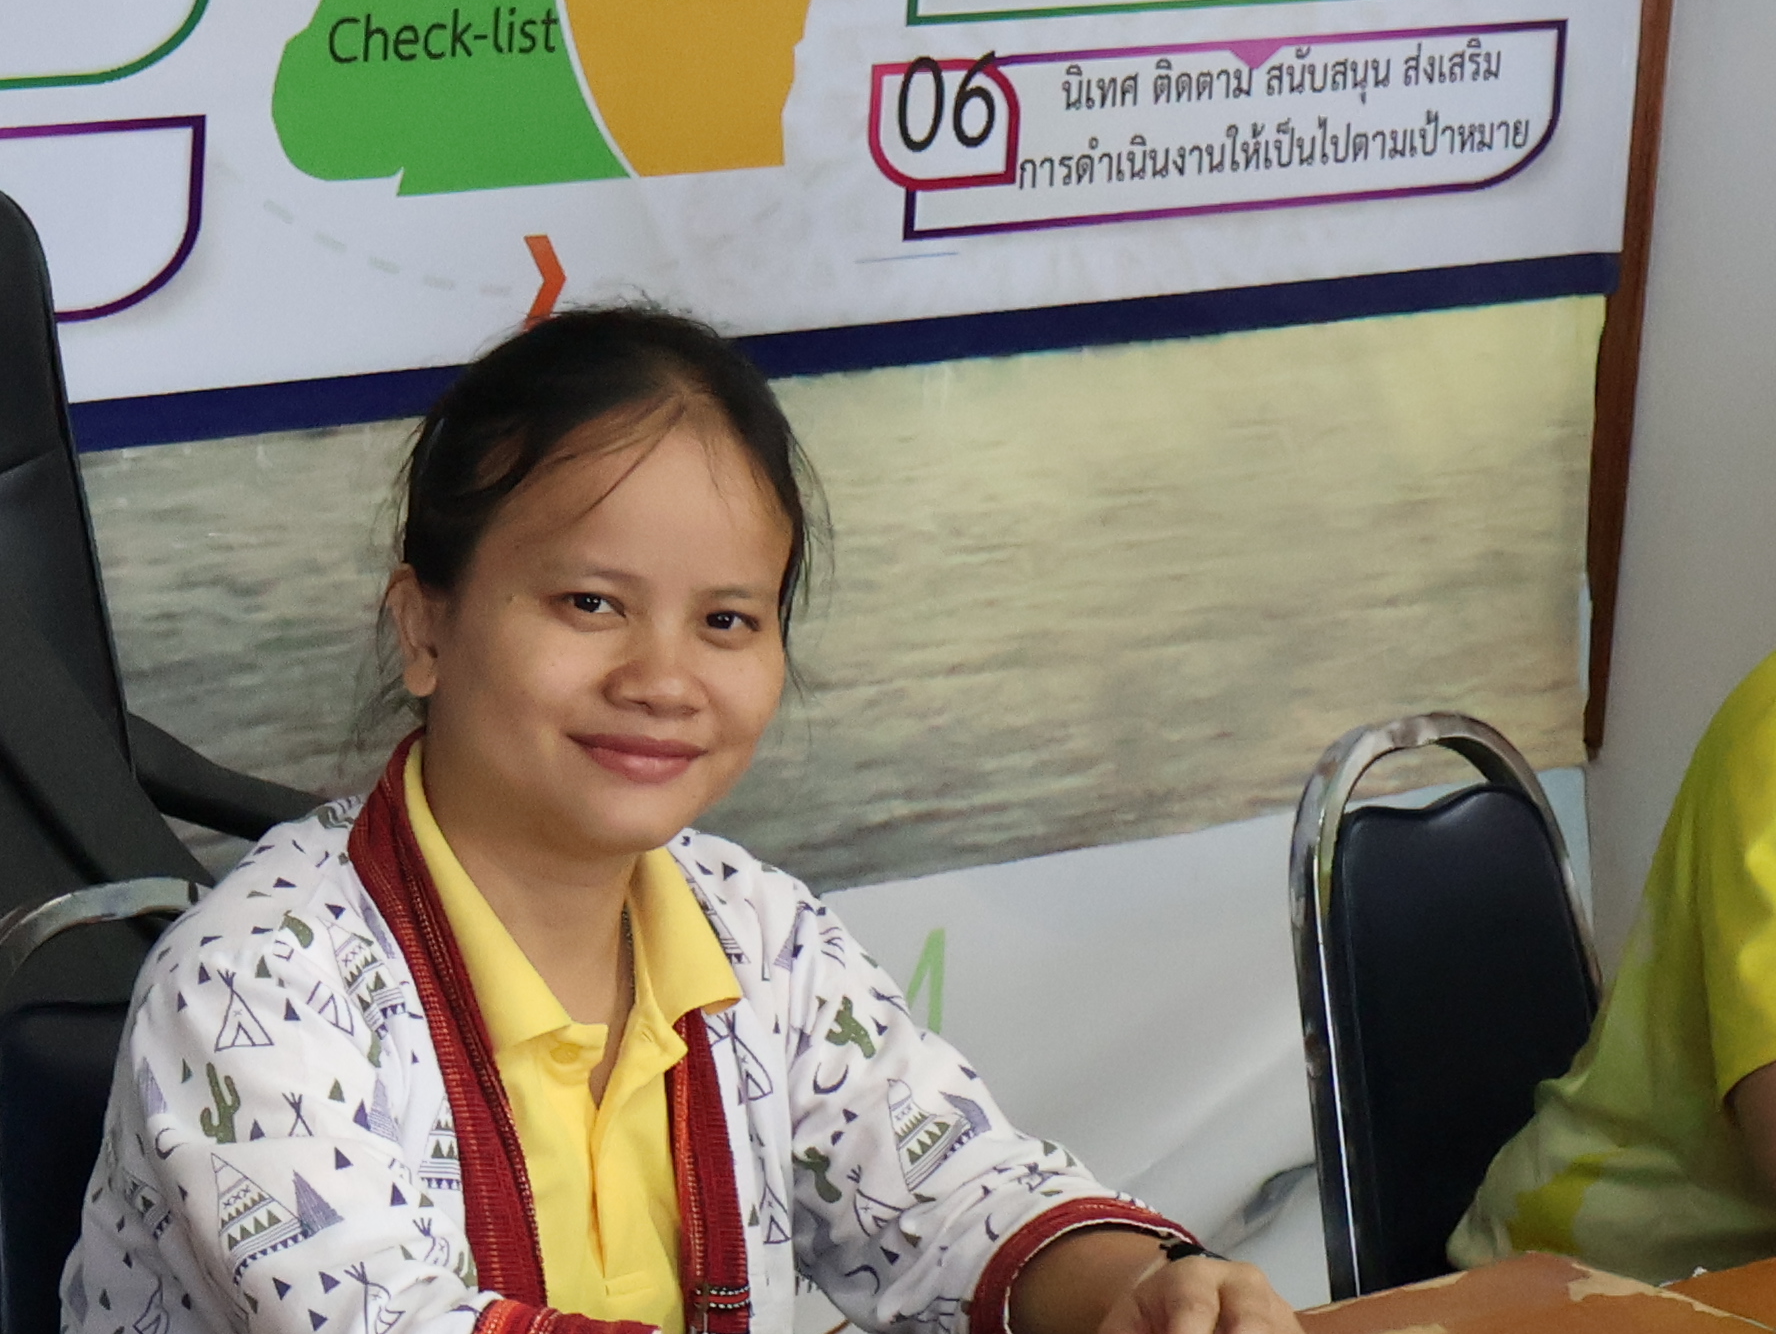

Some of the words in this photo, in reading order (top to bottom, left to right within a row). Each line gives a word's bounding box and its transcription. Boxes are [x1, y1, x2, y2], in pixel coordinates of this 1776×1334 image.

[328, 7, 559, 64] Check-list
[1062, 70, 1139, 110] นิเทศ
[1153, 57, 1255, 104] ติดตาม
[1263, 45, 1391, 104] สนับสนุน
[1401, 36, 1501, 86] ส่งเสริม
[897, 50, 998, 152] 06
[1017, 111, 1530, 190] การดำเนินงานให้เป็นไปตามเป้าหมาย
